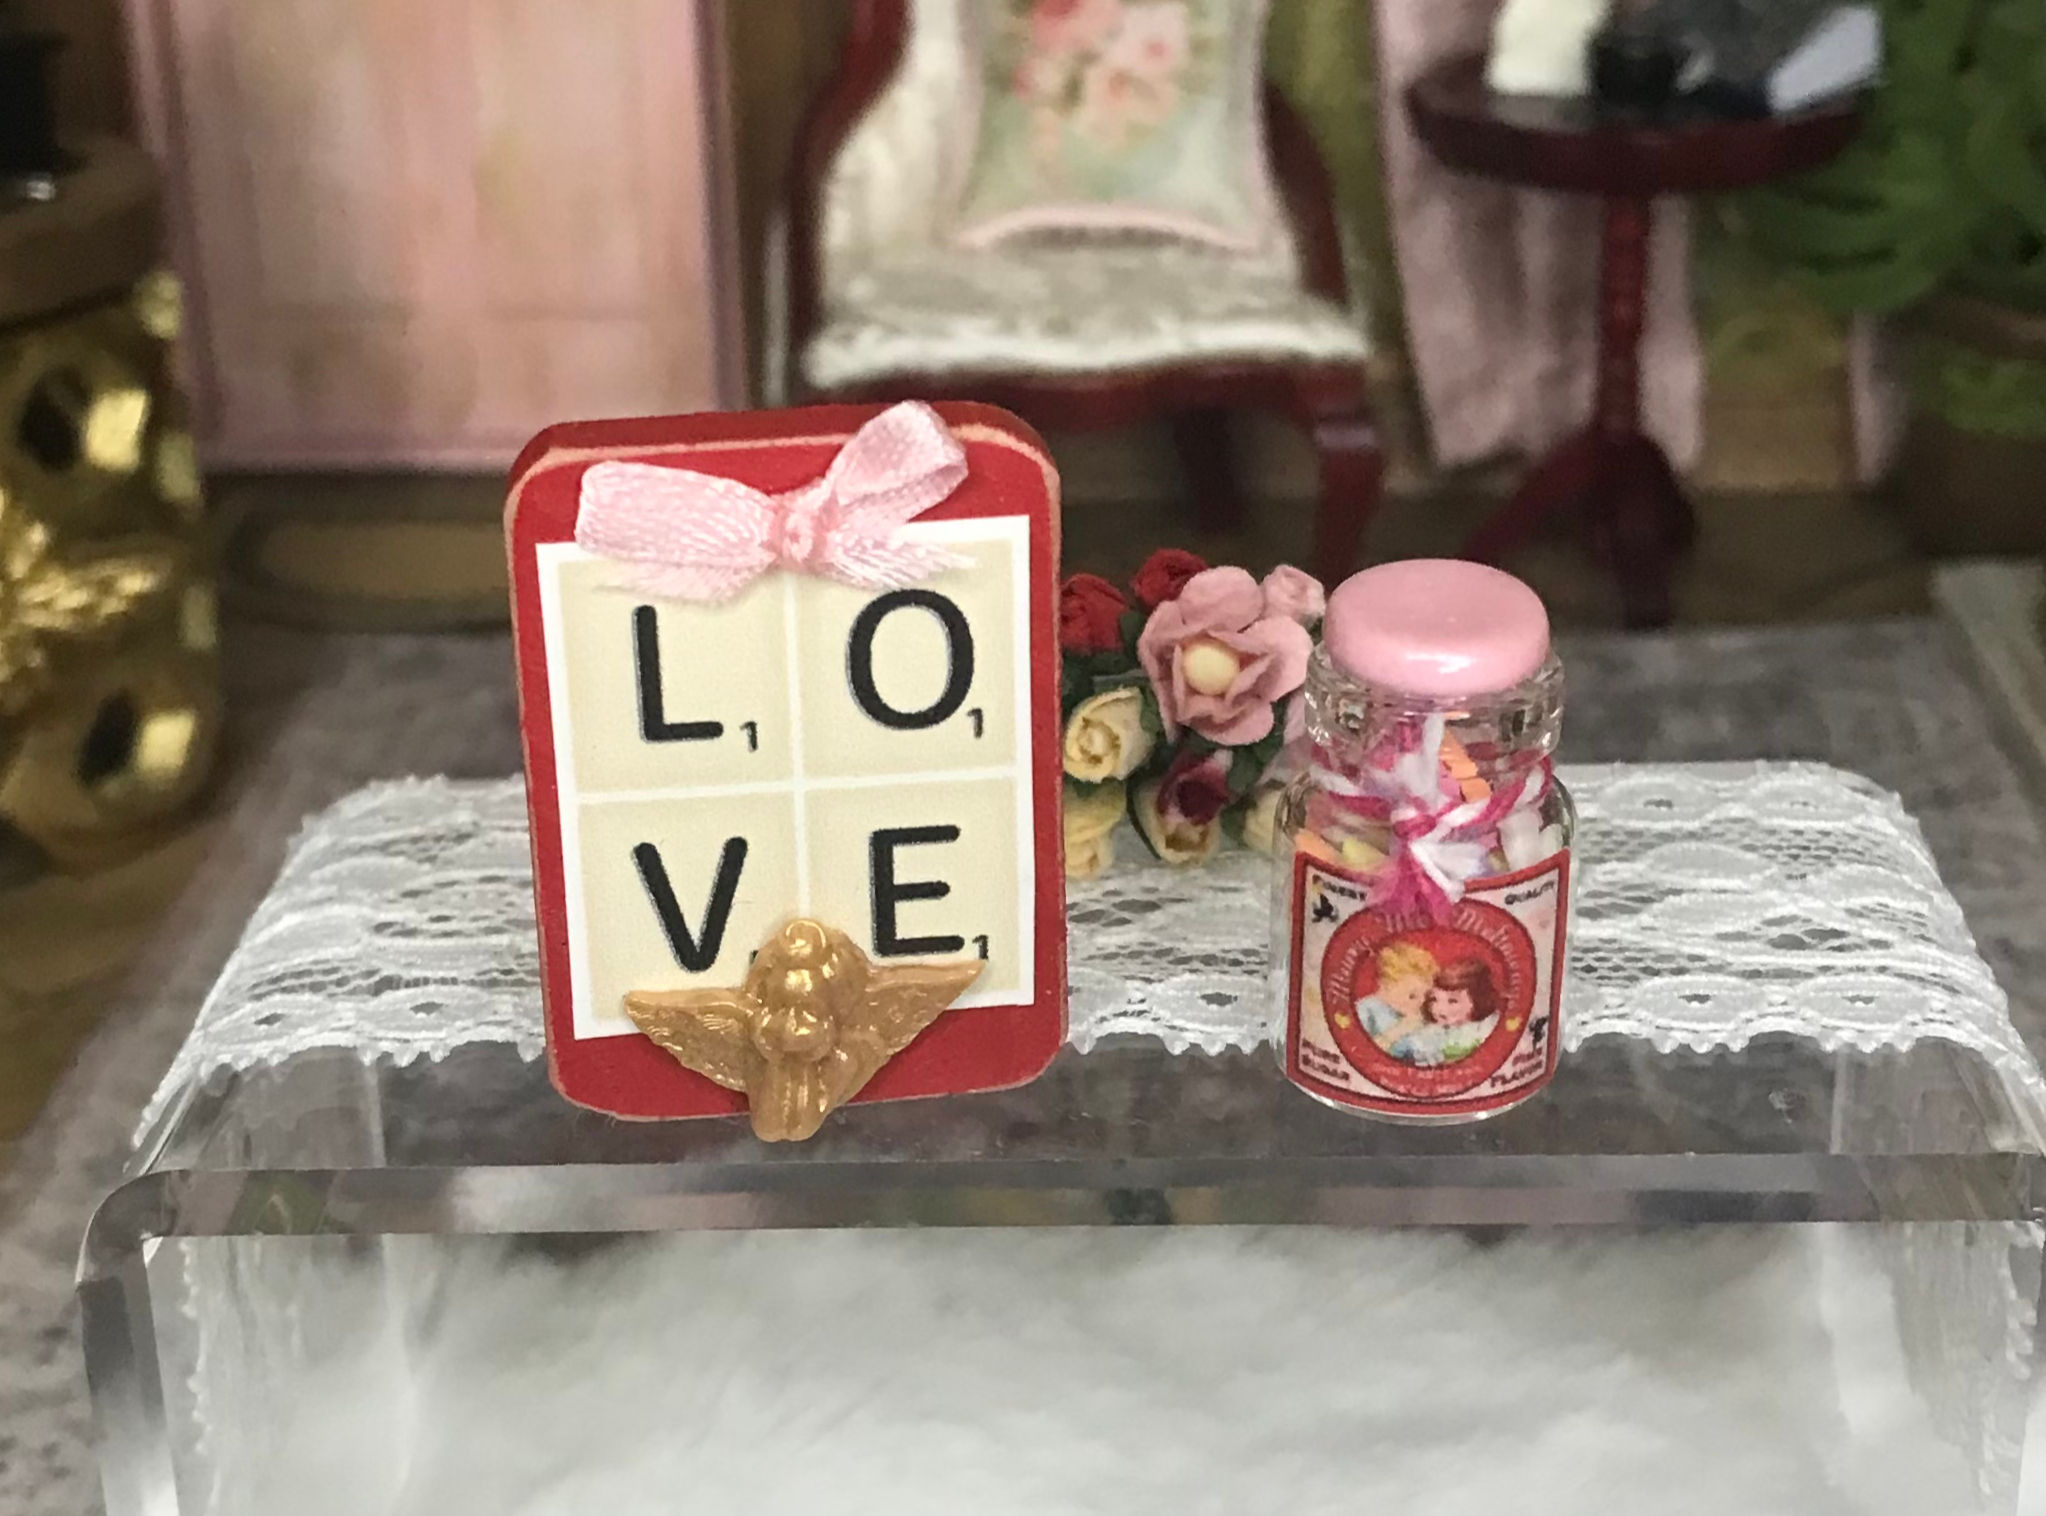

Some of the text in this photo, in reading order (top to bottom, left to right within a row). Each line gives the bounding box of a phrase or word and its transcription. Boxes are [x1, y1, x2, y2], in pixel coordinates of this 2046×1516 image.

[632, 588, 984, 753] L 1 O 1
[631, 824, 989, 974] V E 1
